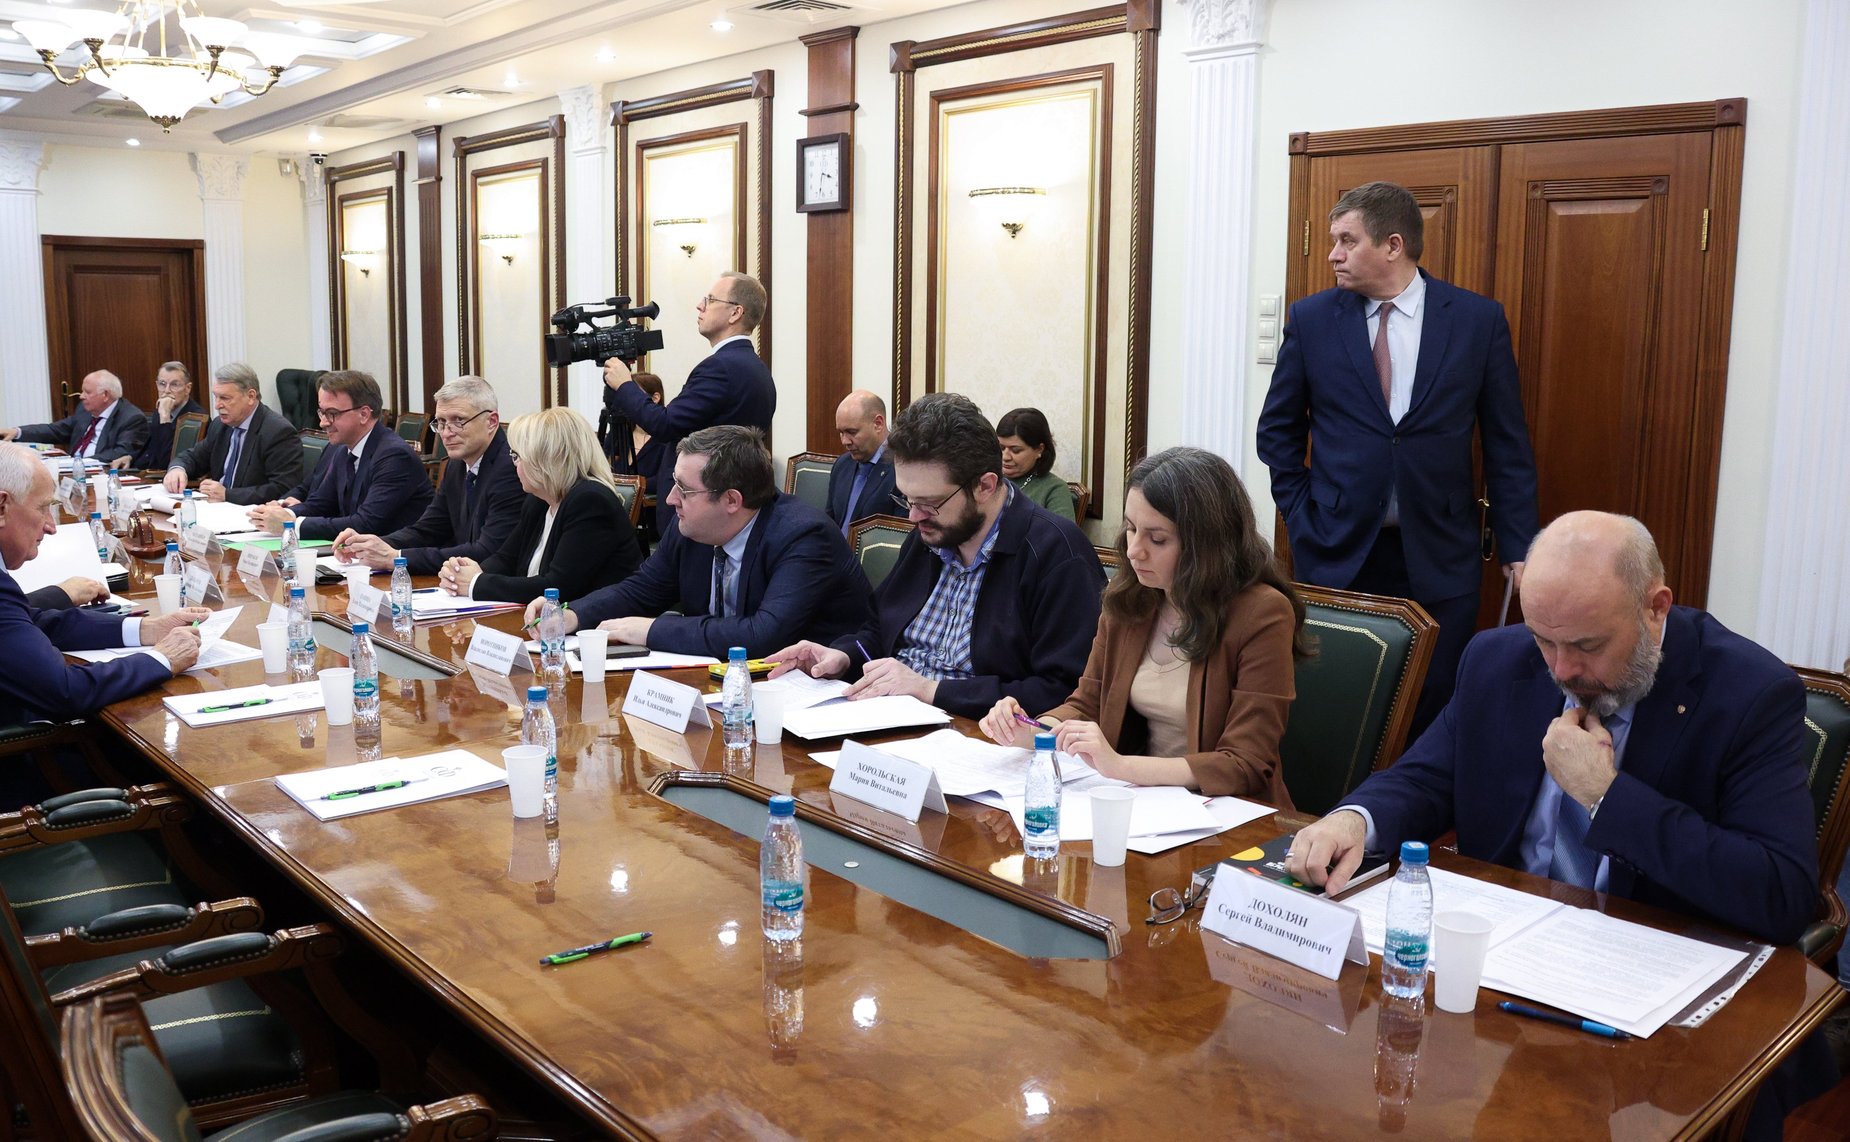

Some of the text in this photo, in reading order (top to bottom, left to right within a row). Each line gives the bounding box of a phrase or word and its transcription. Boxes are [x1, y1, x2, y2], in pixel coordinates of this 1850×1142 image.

[646, 688, 675, 704] КРАМНИК
[848, 771, 908, 799] Мария Витальевна
[857, 762, 907, 786] ХОРОЛЬСКАЯ
[1248, 898, 1309, 928] ДОХОЛЯН
[1218, 903, 1332, 955] Сергей Владимирович
